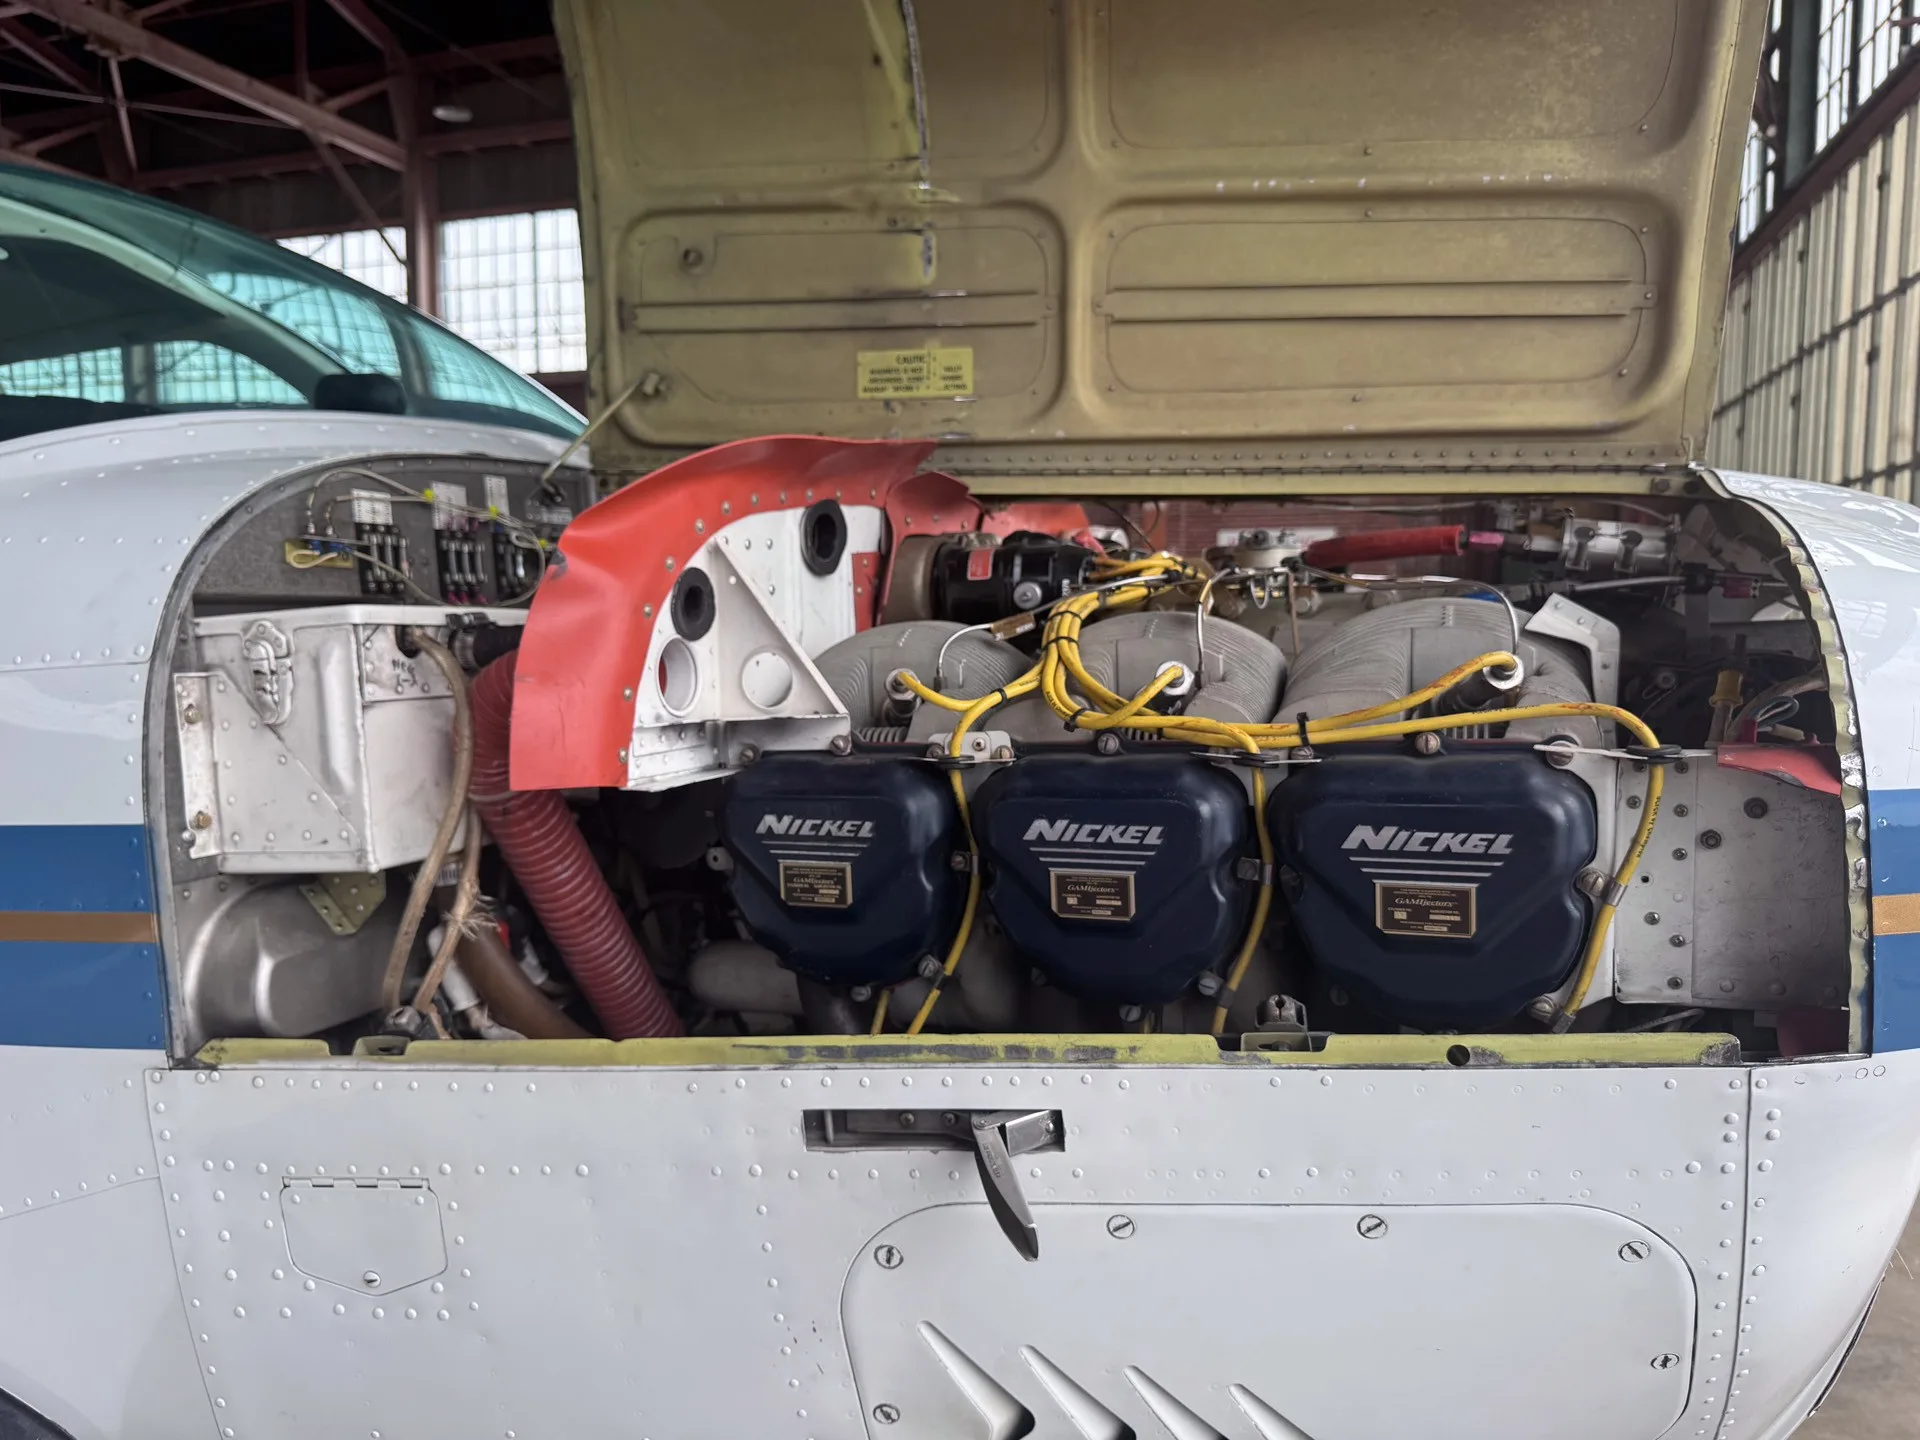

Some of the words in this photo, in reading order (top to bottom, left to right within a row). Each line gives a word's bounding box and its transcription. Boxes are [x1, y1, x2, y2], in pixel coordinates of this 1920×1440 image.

[755, 814, 875, 837] NICKEL
[1023, 819, 1164, 845] NICKEL
[1340, 825, 1514, 854] NICKEL
